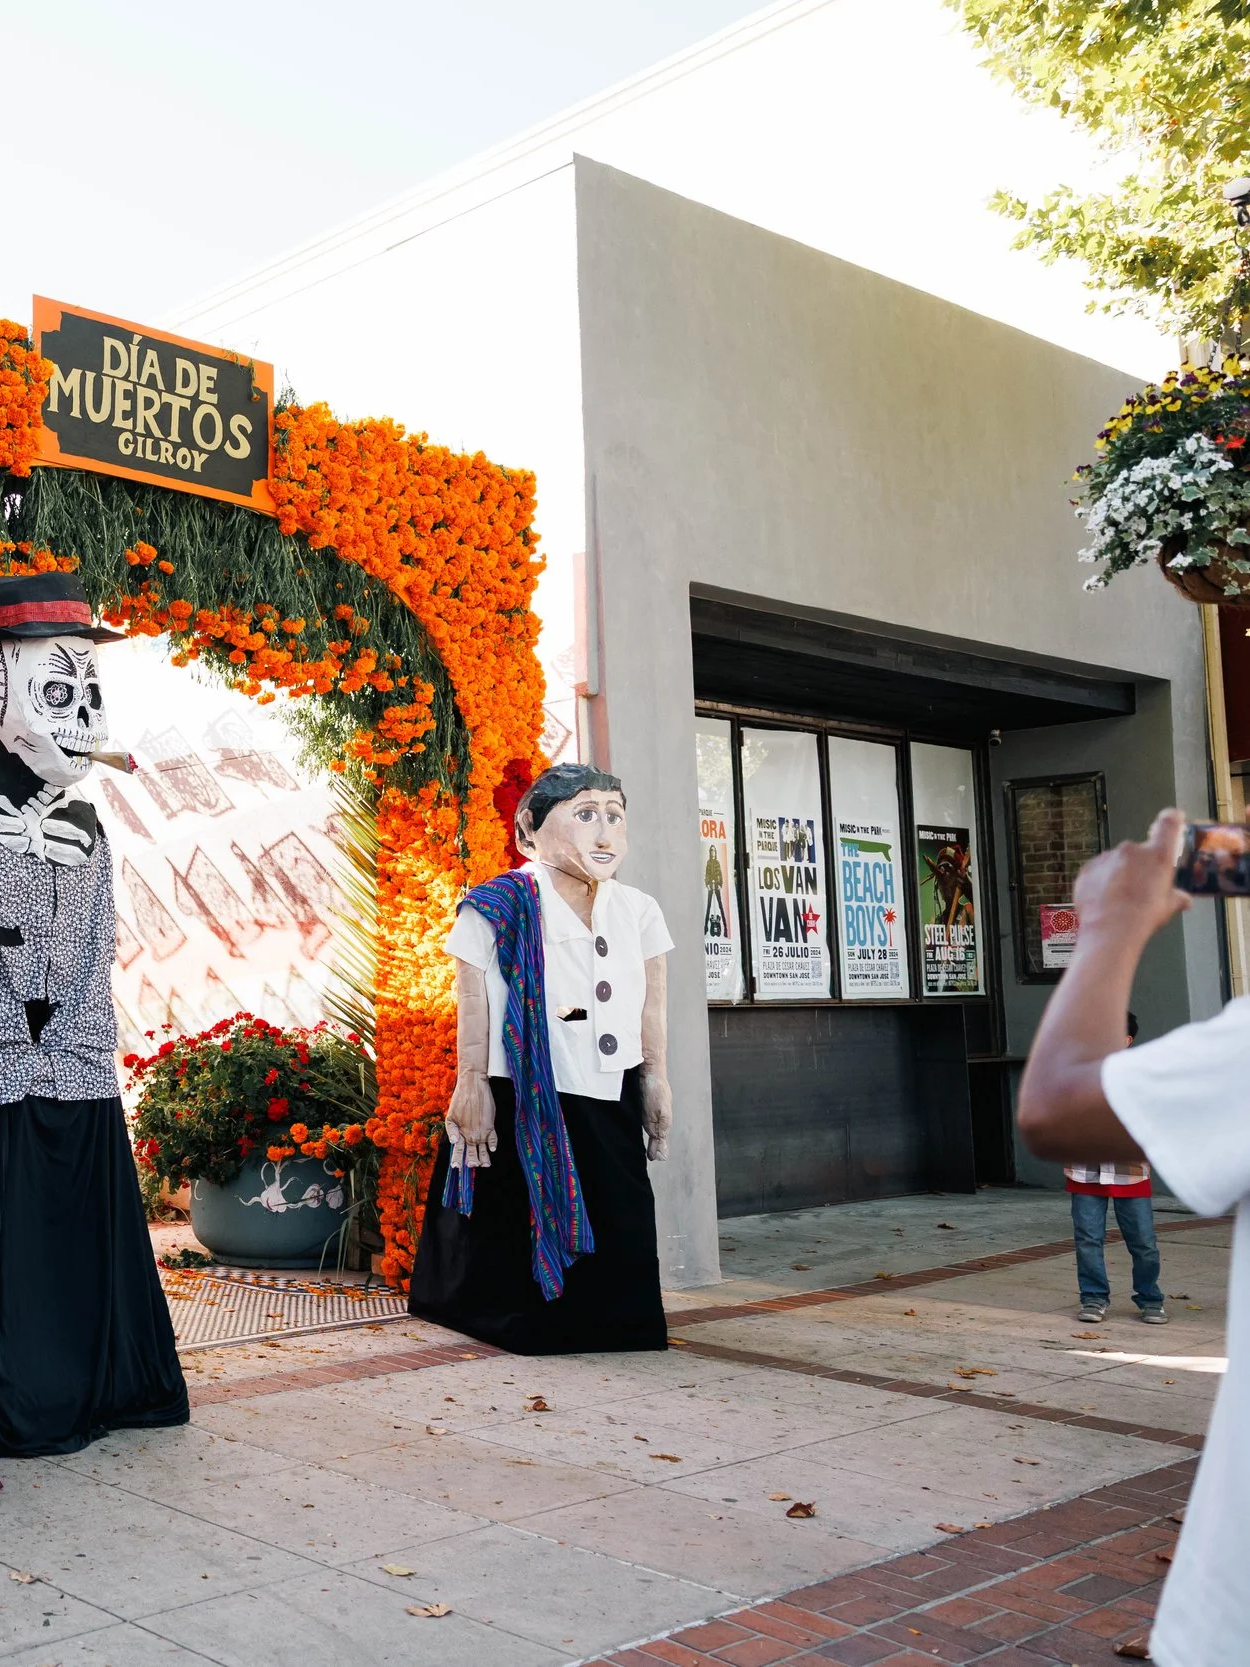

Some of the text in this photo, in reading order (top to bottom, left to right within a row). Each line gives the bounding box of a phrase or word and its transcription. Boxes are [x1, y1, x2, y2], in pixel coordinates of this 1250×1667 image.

[102, 334, 218, 404] DÍA DE
[47, 364, 253, 459] MUERTOS
[118, 431, 209, 473] GILROY
[700, 819, 727, 839] ORA
[756, 818, 777, 830] MUSIC
[839, 823, 857, 834] MUSIC
[860, 826, 870, 834] THE
[870, 826, 882, 836] PARK
[764, 831, 775, 840] THE
[919, 830, 934, 840] MUSIC
[946, 832, 957, 842] PARK
[757, 841, 778, 852] PARQUE
[840, 842, 860, 858] THE
[758, 865, 818, 895] LOS VAN
[842, 860, 895, 904] BEACH
[759, 896, 808, 943] VAN
[845, 905, 888, 947] BOYS
[924, 923, 975, 946] STEEL PULSE
[772, 946, 784, 958] 26
[785, 946, 809, 958] JULIO
[857, 948, 876, 960] JULY
[877, 949, 888, 960] 28
[935, 946, 954, 961] AUG
[956, 946, 965, 961] 16
